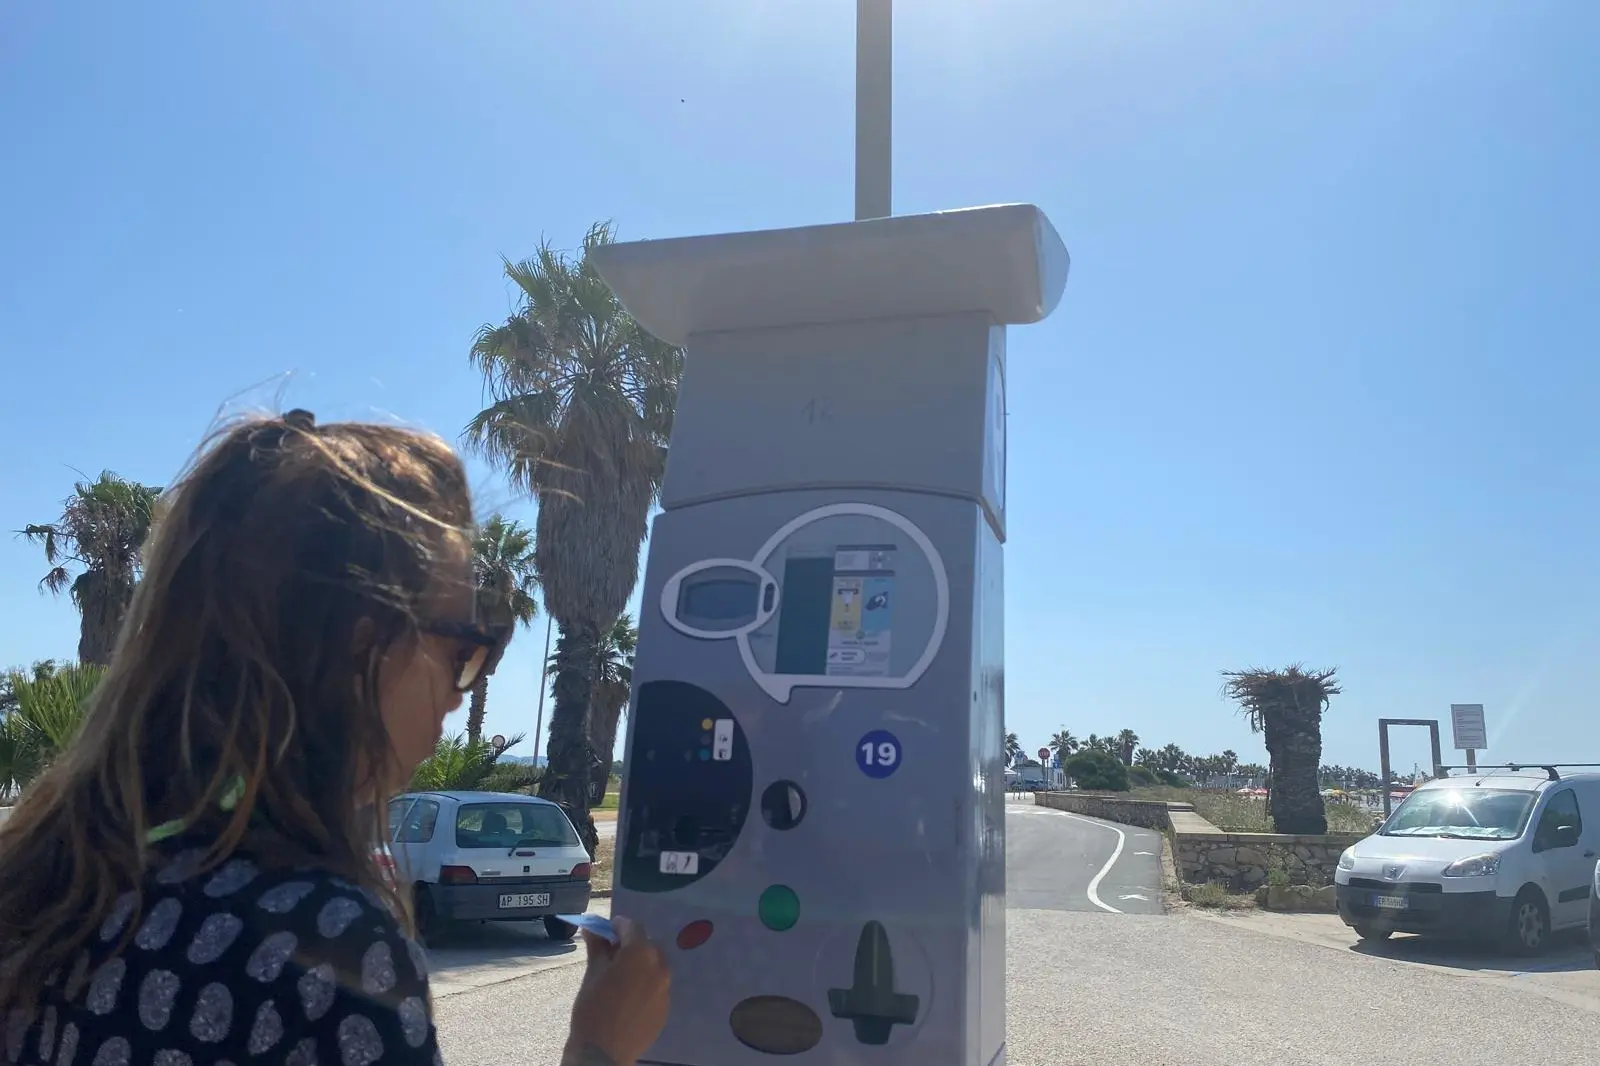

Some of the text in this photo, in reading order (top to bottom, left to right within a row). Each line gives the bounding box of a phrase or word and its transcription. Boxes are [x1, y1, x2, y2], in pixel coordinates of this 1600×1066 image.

[862, 742, 896, 766] 19
[501, 894, 549, 907] AP 195 SH
